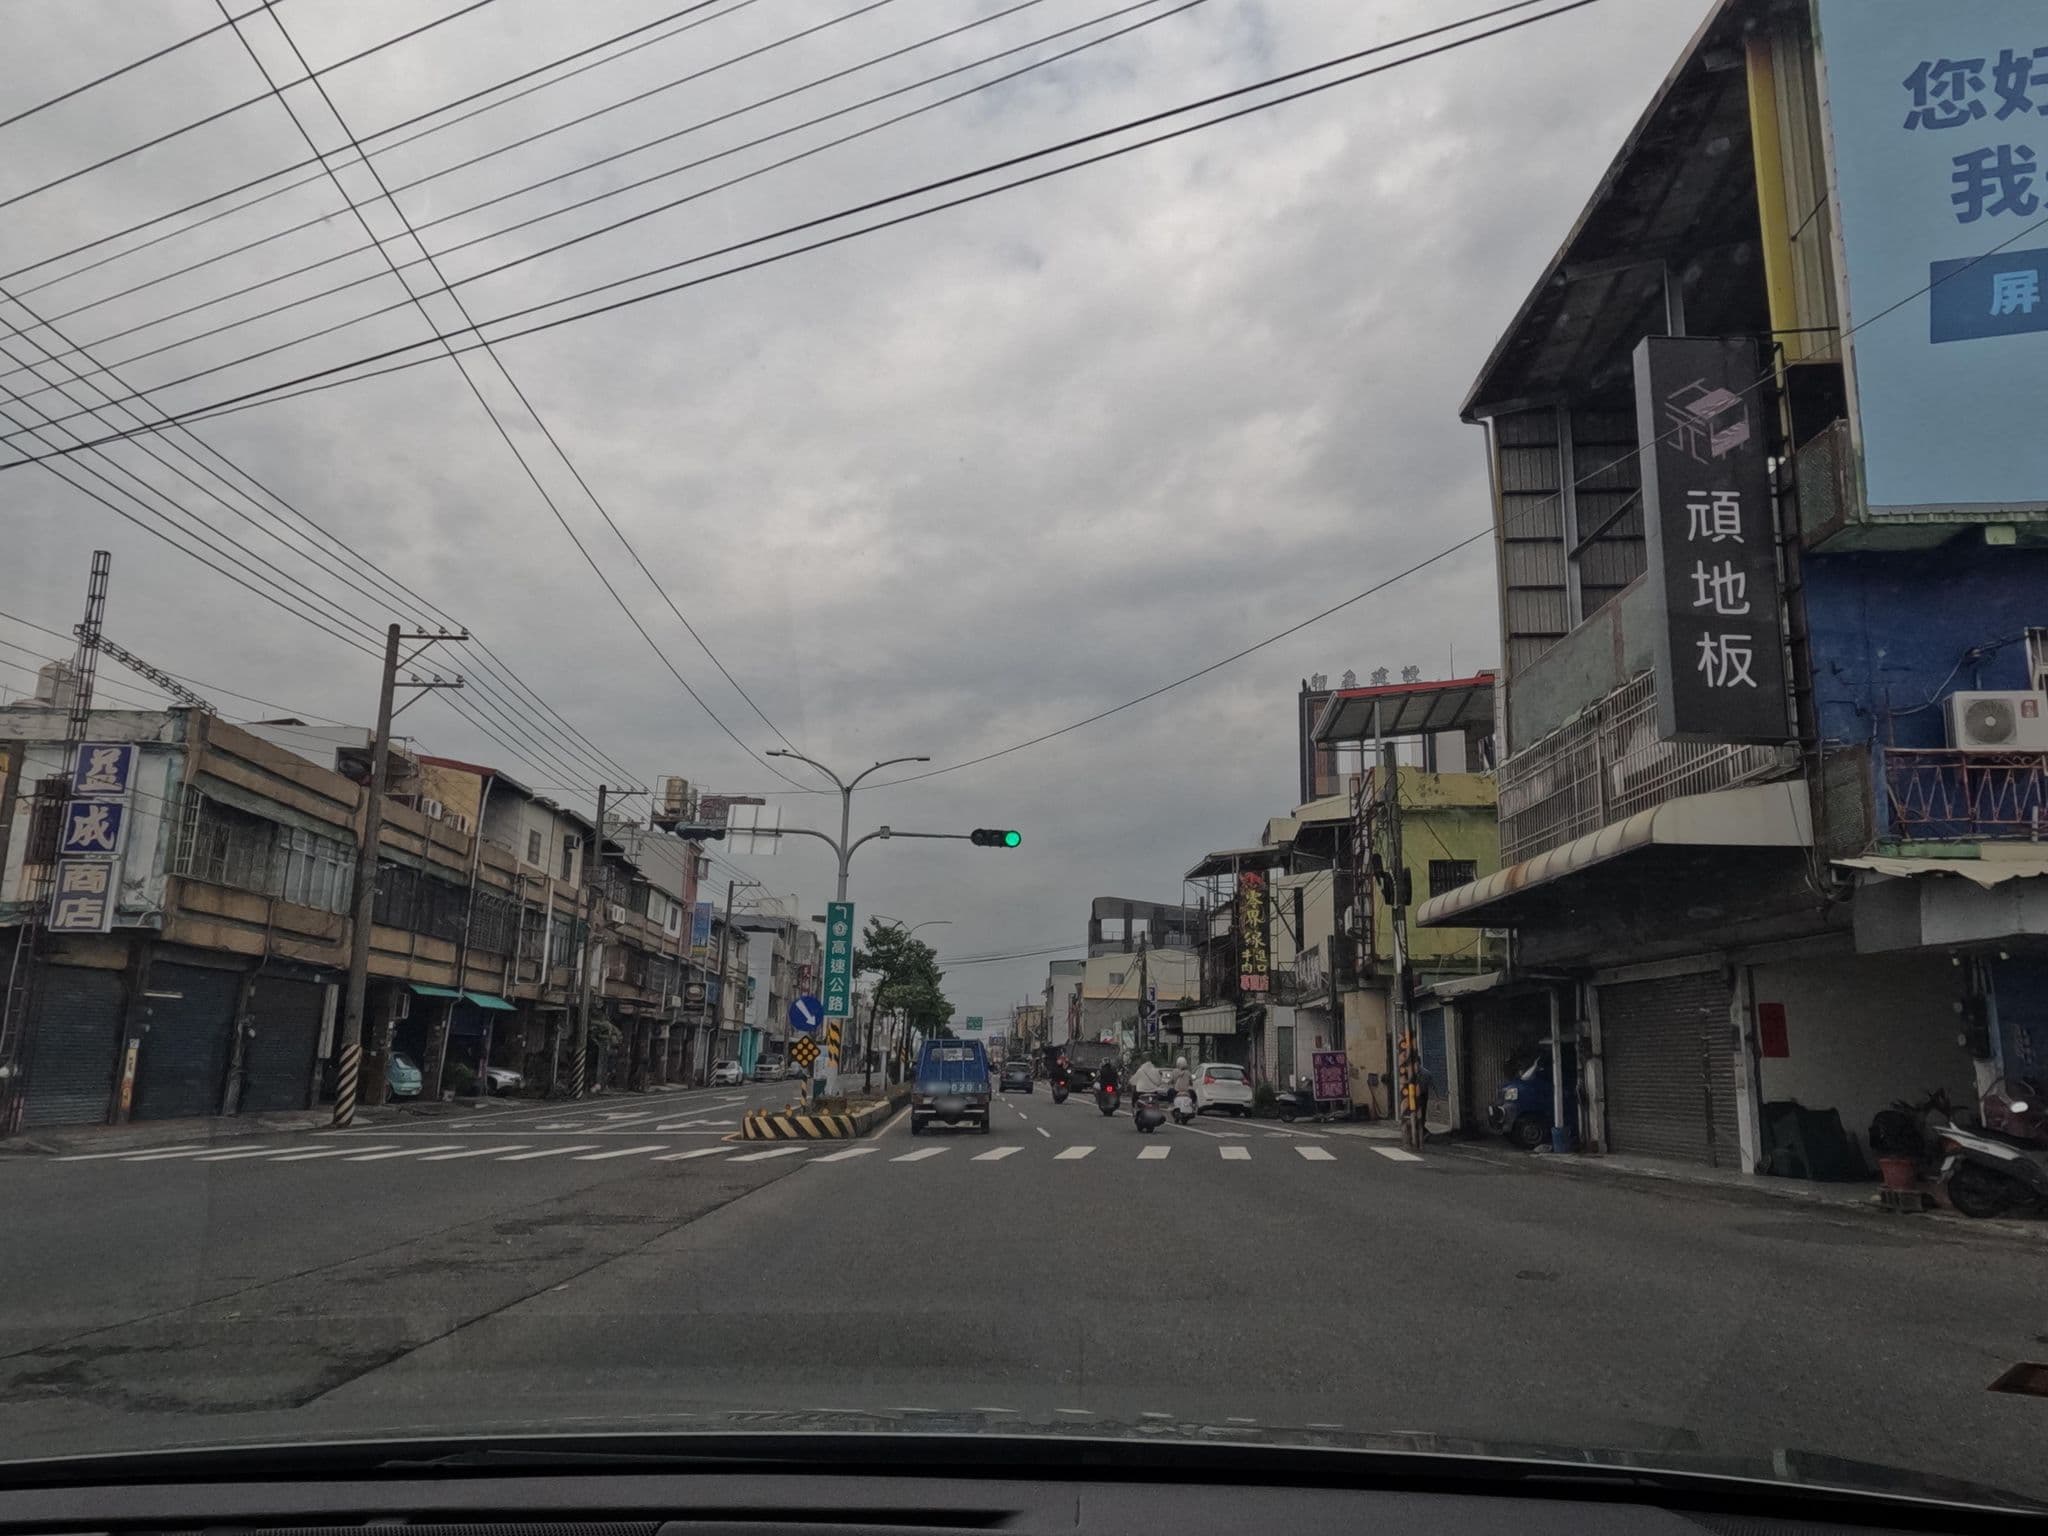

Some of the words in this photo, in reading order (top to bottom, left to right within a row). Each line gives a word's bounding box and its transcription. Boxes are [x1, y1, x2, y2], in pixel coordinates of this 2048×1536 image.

[1902, 47, 2048, 132] 您好
[1950, 144, 2048, 225] 我
[1990, 269, 2041, 317] 屏
[1686, 490, 1758, 689] 頑地板
[828, 939, 846, 1012] 高速公路
